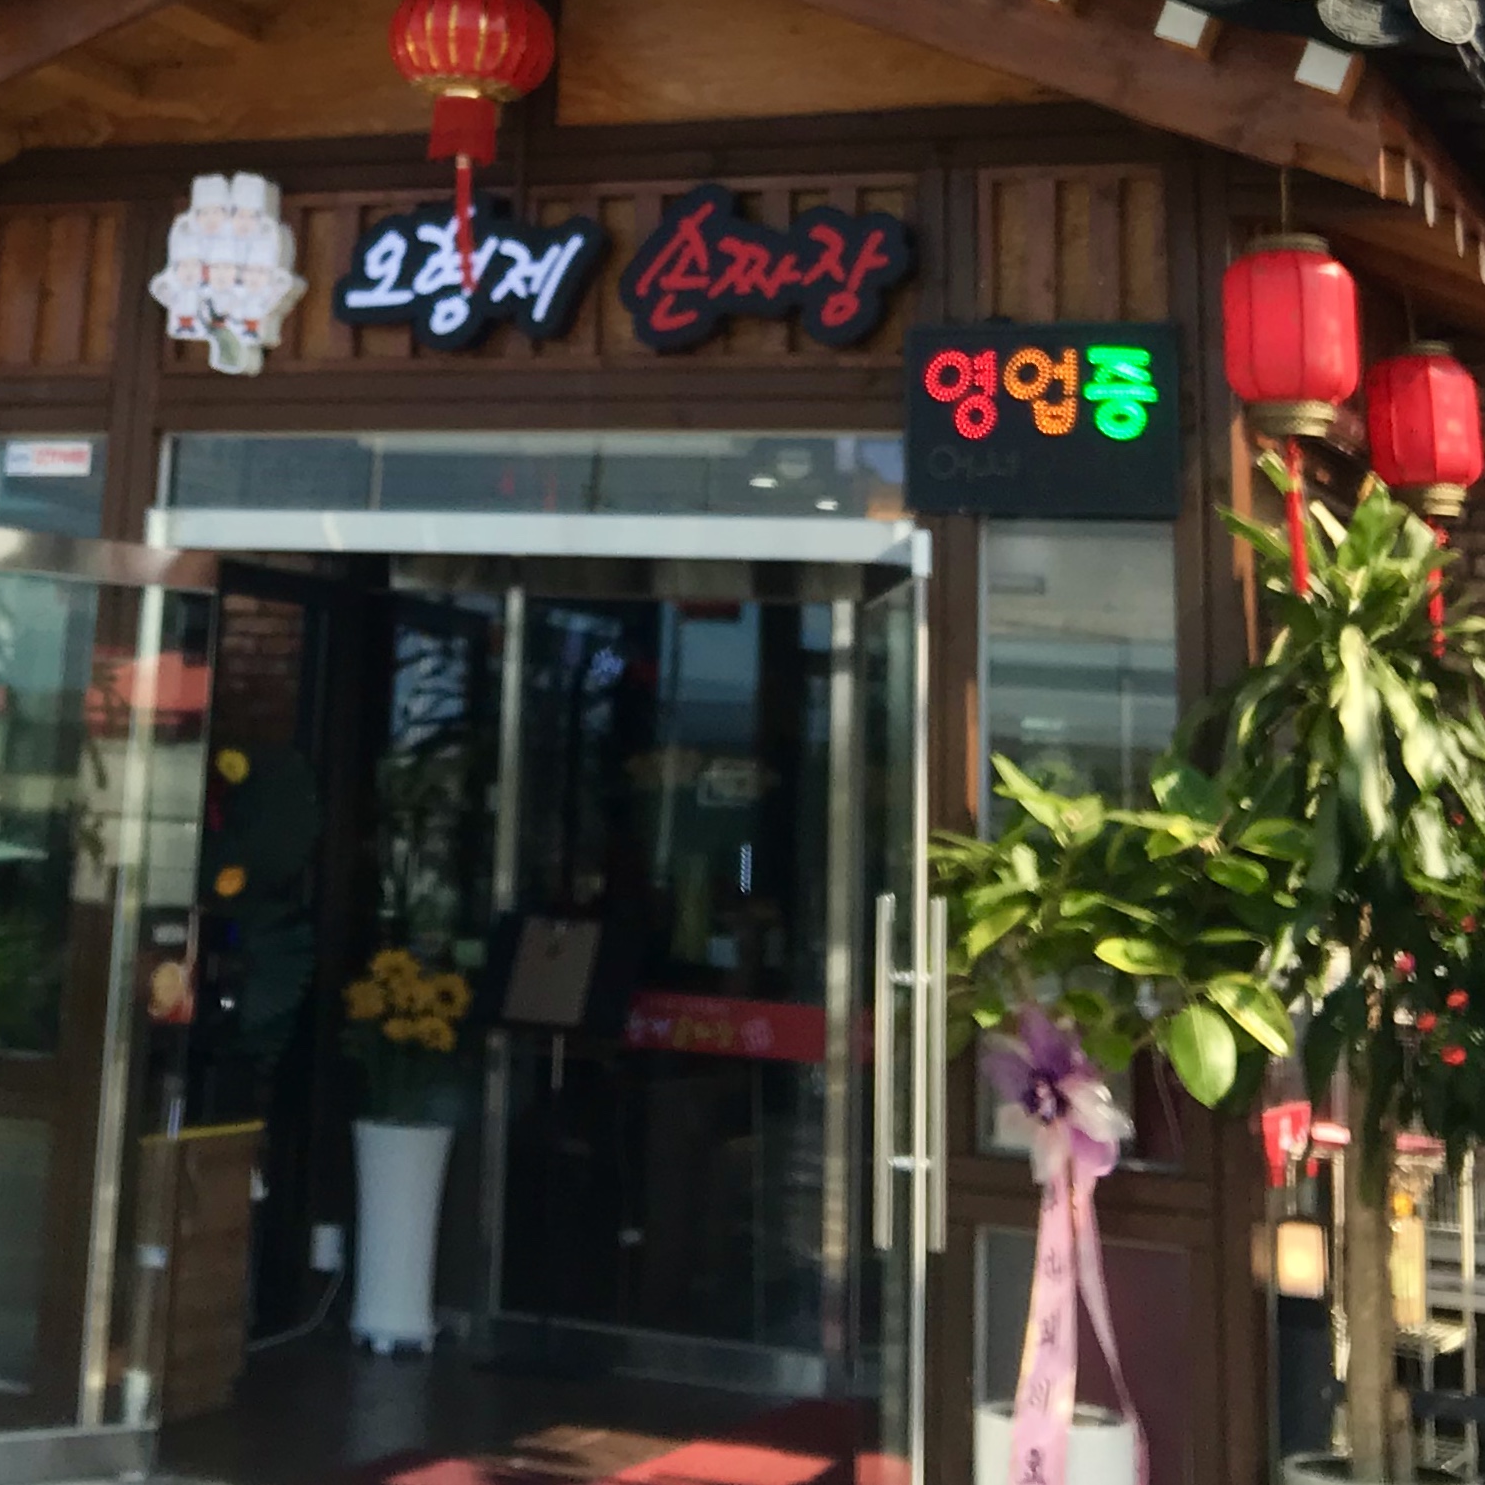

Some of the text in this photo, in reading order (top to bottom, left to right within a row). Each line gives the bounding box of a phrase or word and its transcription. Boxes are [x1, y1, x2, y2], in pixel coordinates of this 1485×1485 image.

[345, 202, 891, 336] 오형제 손짜장
[923, 345, 1160, 442] 영업중
